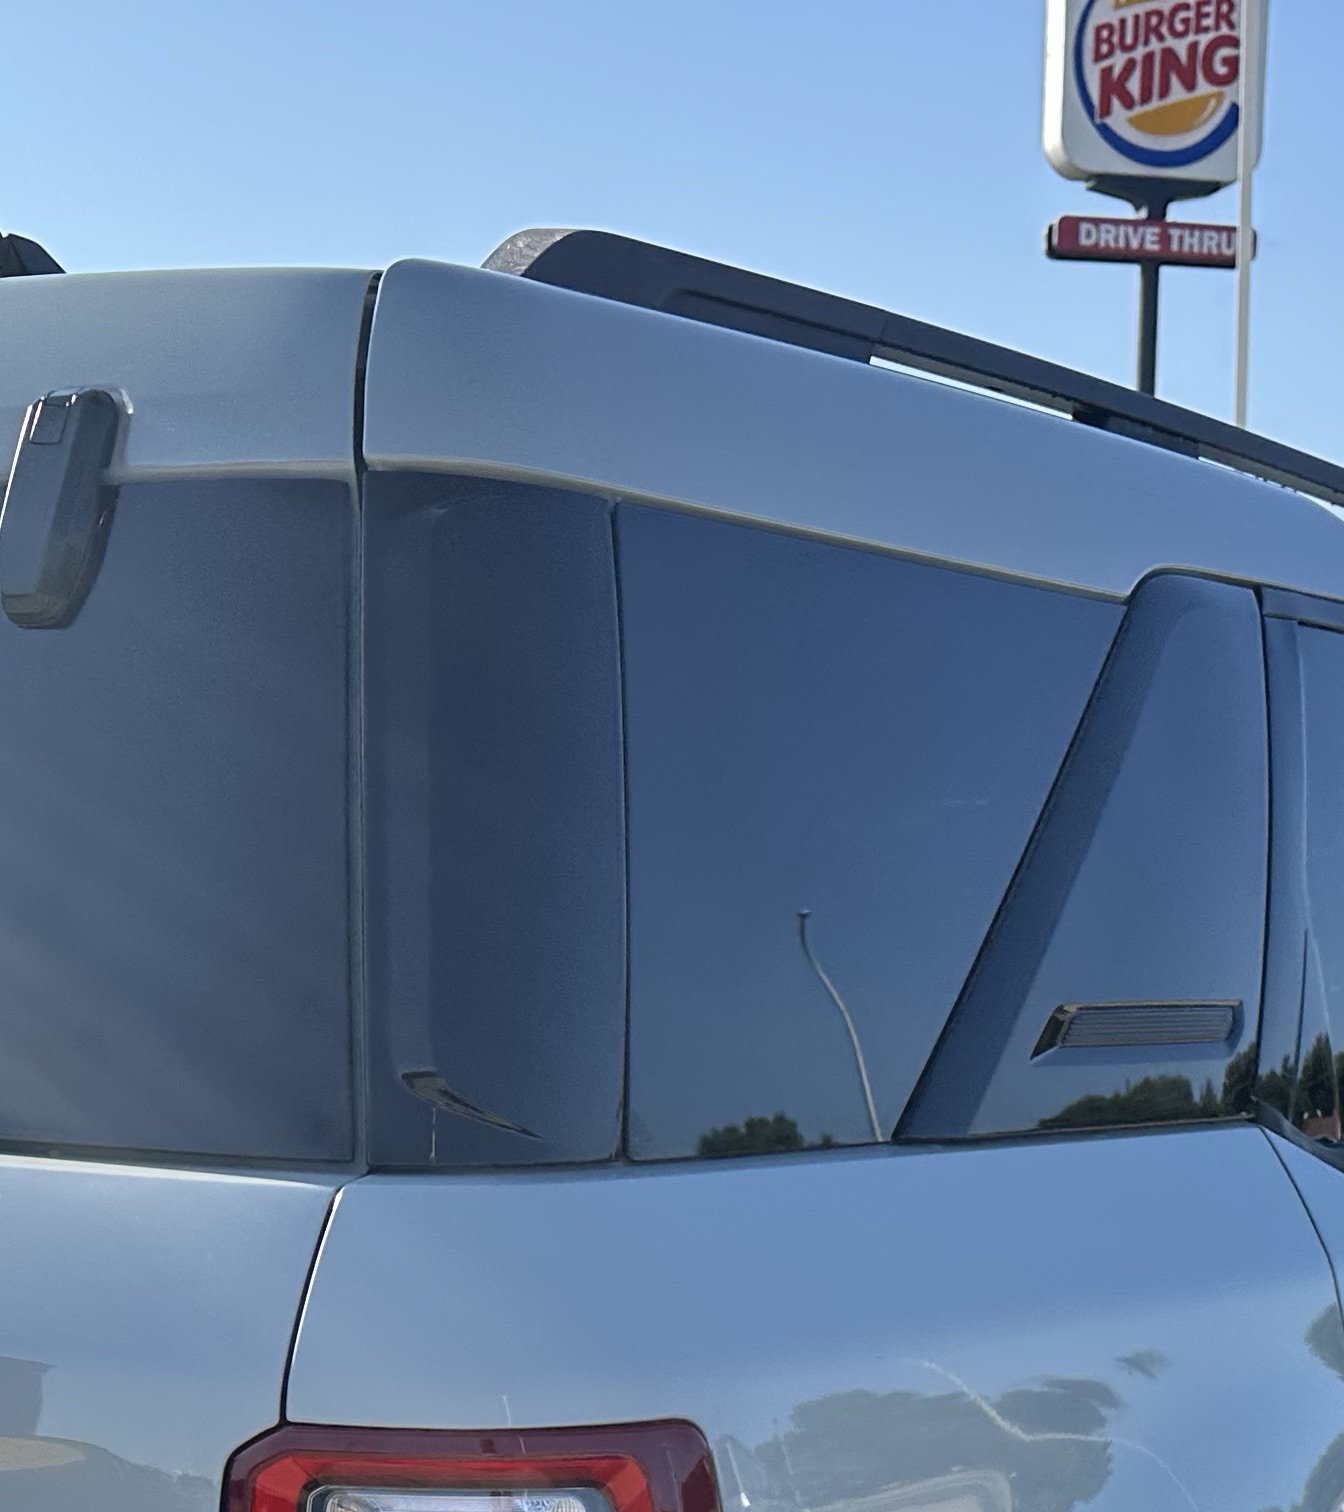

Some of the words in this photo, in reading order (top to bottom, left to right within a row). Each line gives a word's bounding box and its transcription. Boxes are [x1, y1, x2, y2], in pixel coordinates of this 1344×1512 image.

[1093, 0, 1236, 63] BURGER
[1098, 34, 1241, 119] KING
[1078, 221, 1162, 251] DRIVE
[1167, 226, 1237, 255] THRU
